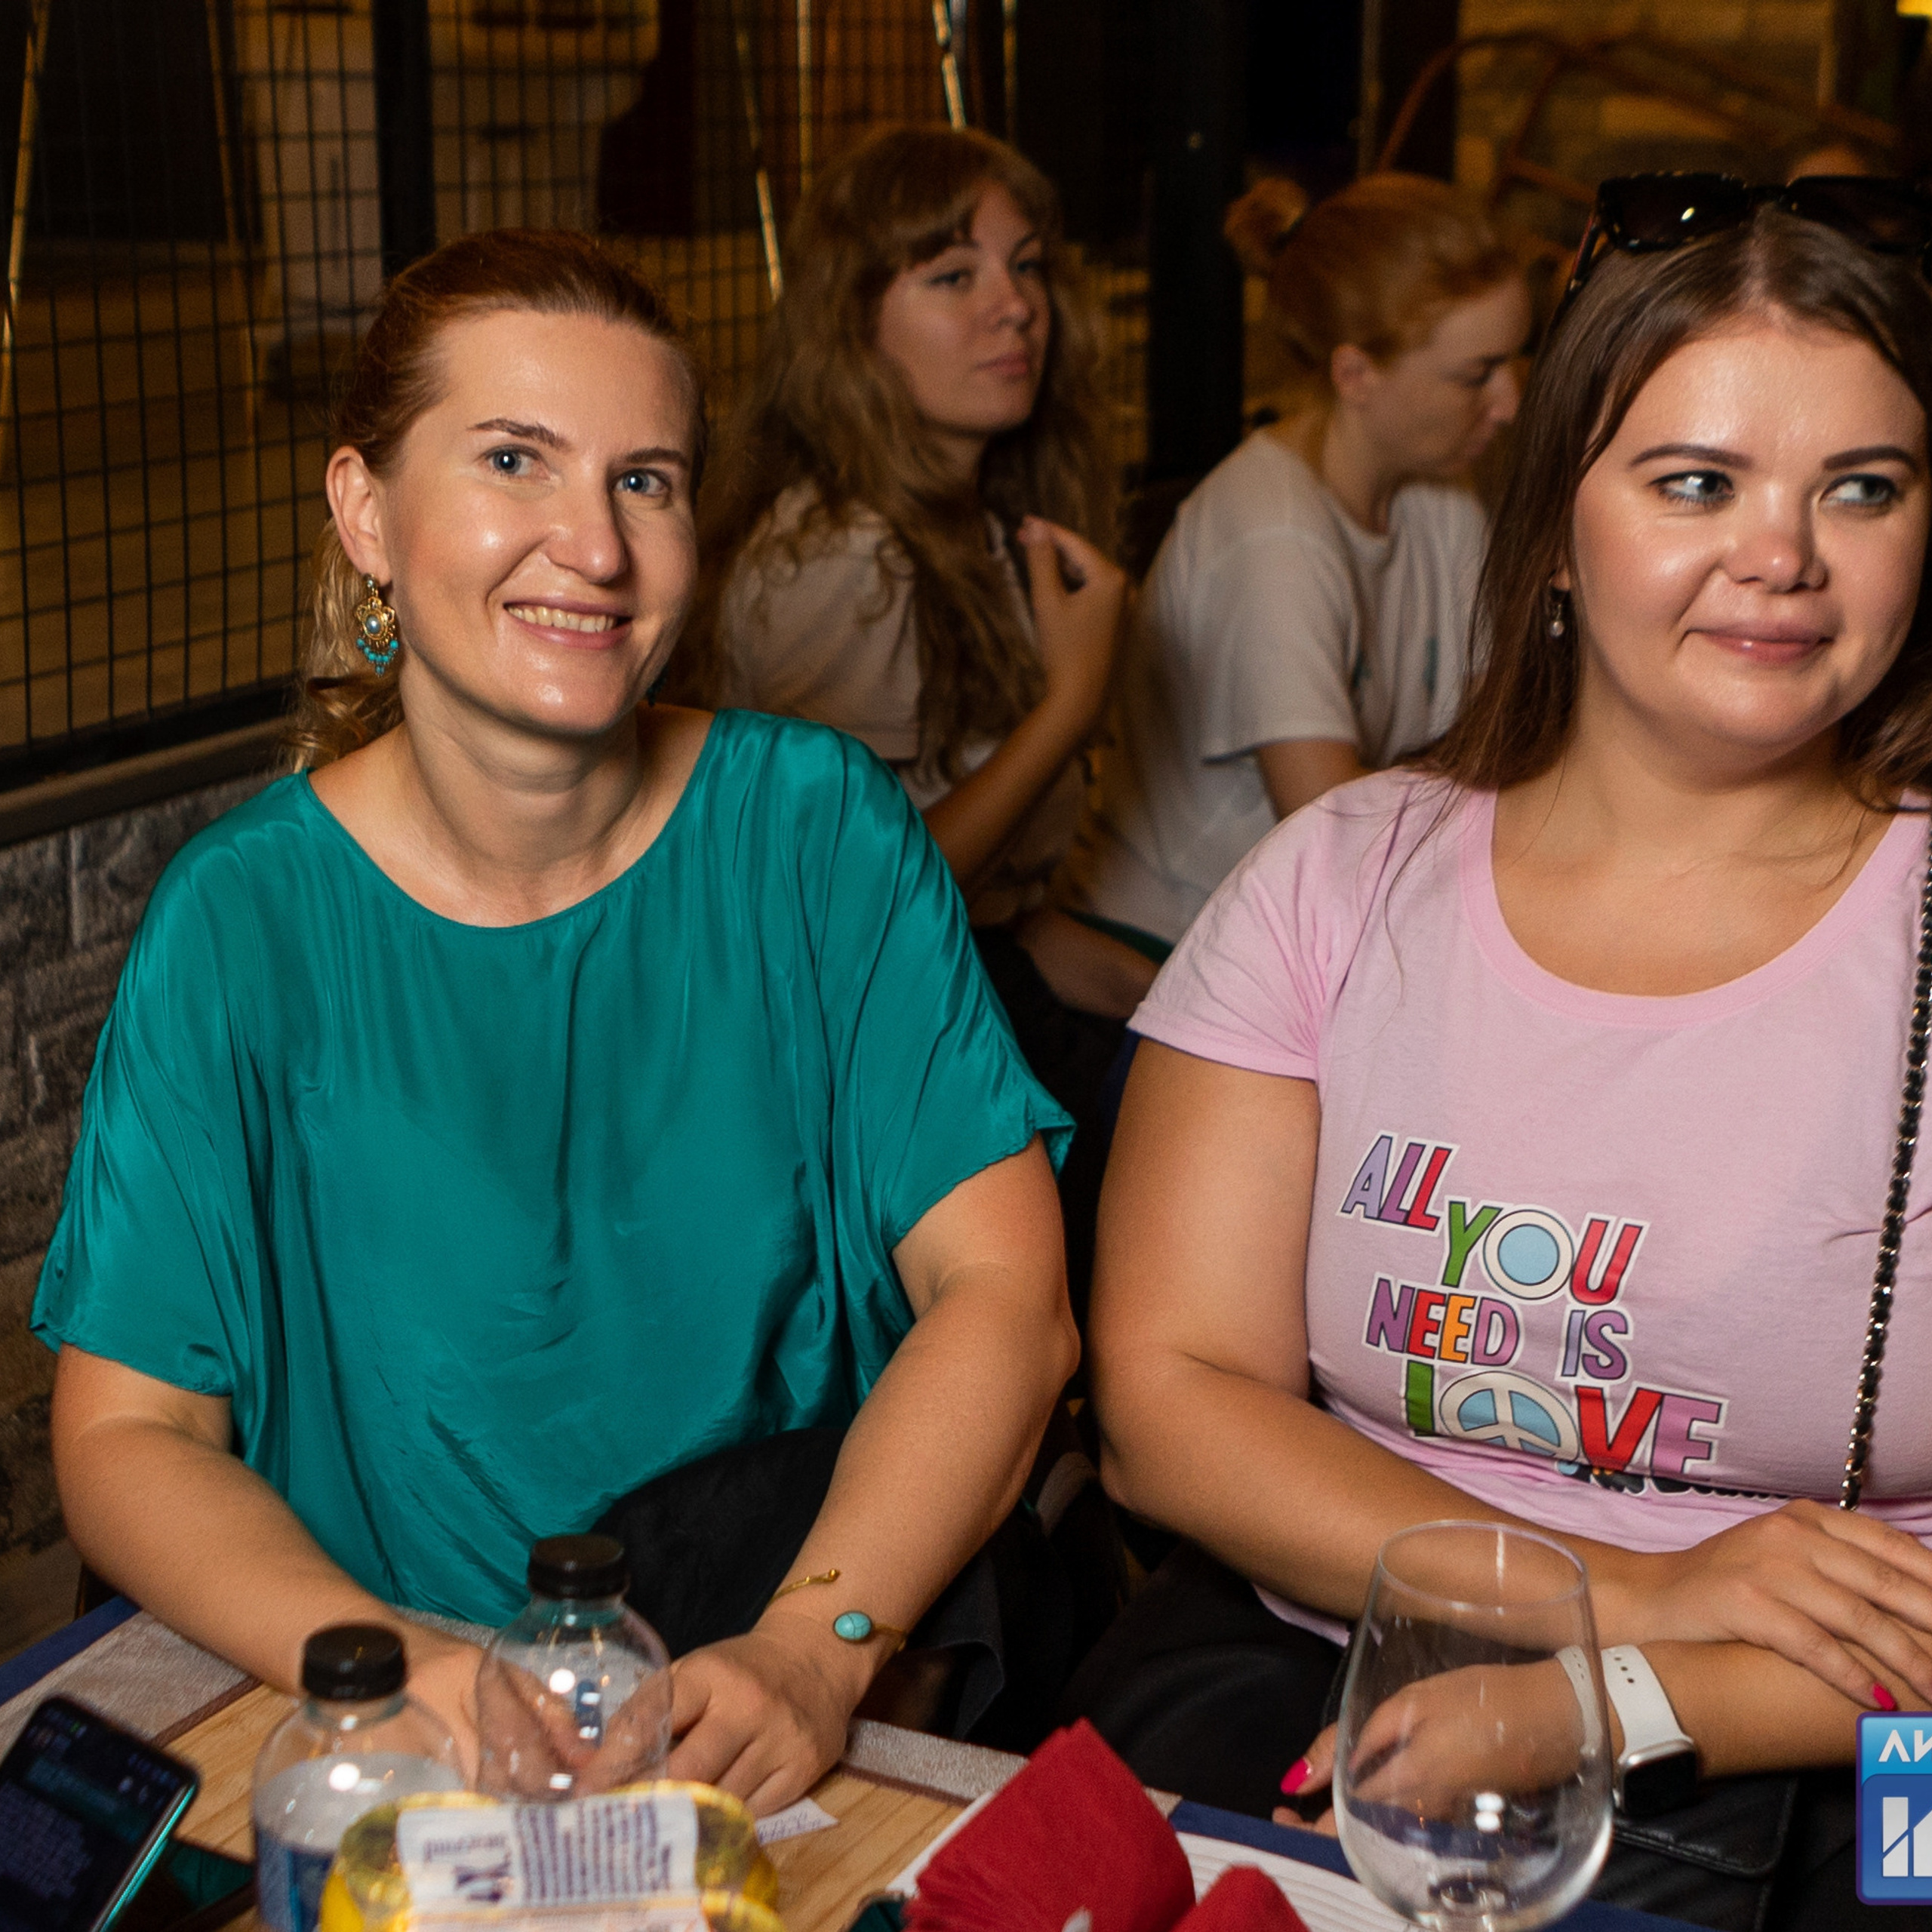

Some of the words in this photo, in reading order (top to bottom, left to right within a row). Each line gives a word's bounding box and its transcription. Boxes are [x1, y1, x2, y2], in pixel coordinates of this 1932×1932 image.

[1339, 1133, 1455, 1233] ALL
[1438, 1199, 1645, 1306] YOU
[1364, 1276, 1521, 1367] NEED
[1559, 1308, 1630, 1381] IS
[1404, 1358, 1724, 1475] LOVE
